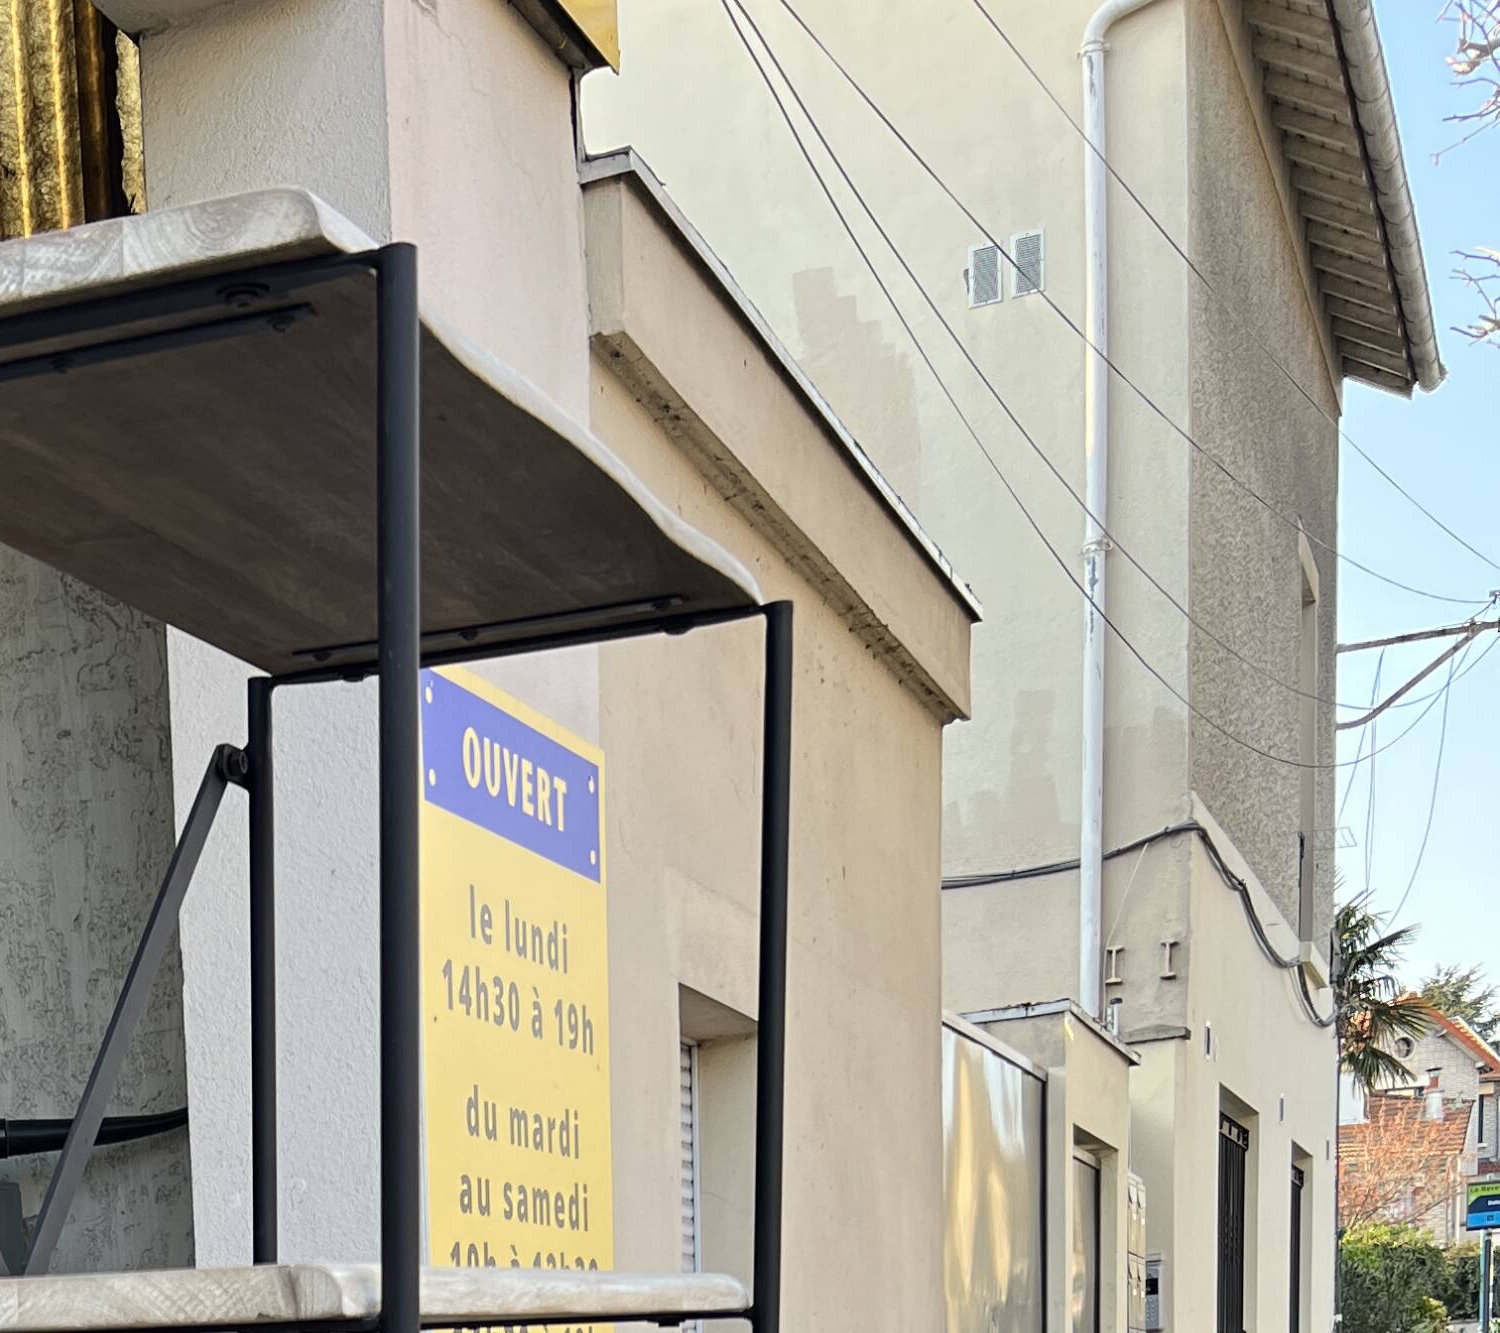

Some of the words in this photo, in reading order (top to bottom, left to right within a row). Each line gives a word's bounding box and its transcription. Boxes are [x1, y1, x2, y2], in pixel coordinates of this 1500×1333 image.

[462, 726, 567, 832] OUVERT
[469, 884, 493, 945] le
[505, 899, 568, 974] lundi
[442, 958, 520, 1032] 14h30
[531, 986, 543, 1039] à
[554, 998, 594, 1056] 19h
[466, 1084, 498, 1141] du
[509, 1108, 580, 1159] mardi
[459, 1174, 491, 1217] au
[503, 1181, 589, 1232] samedi
